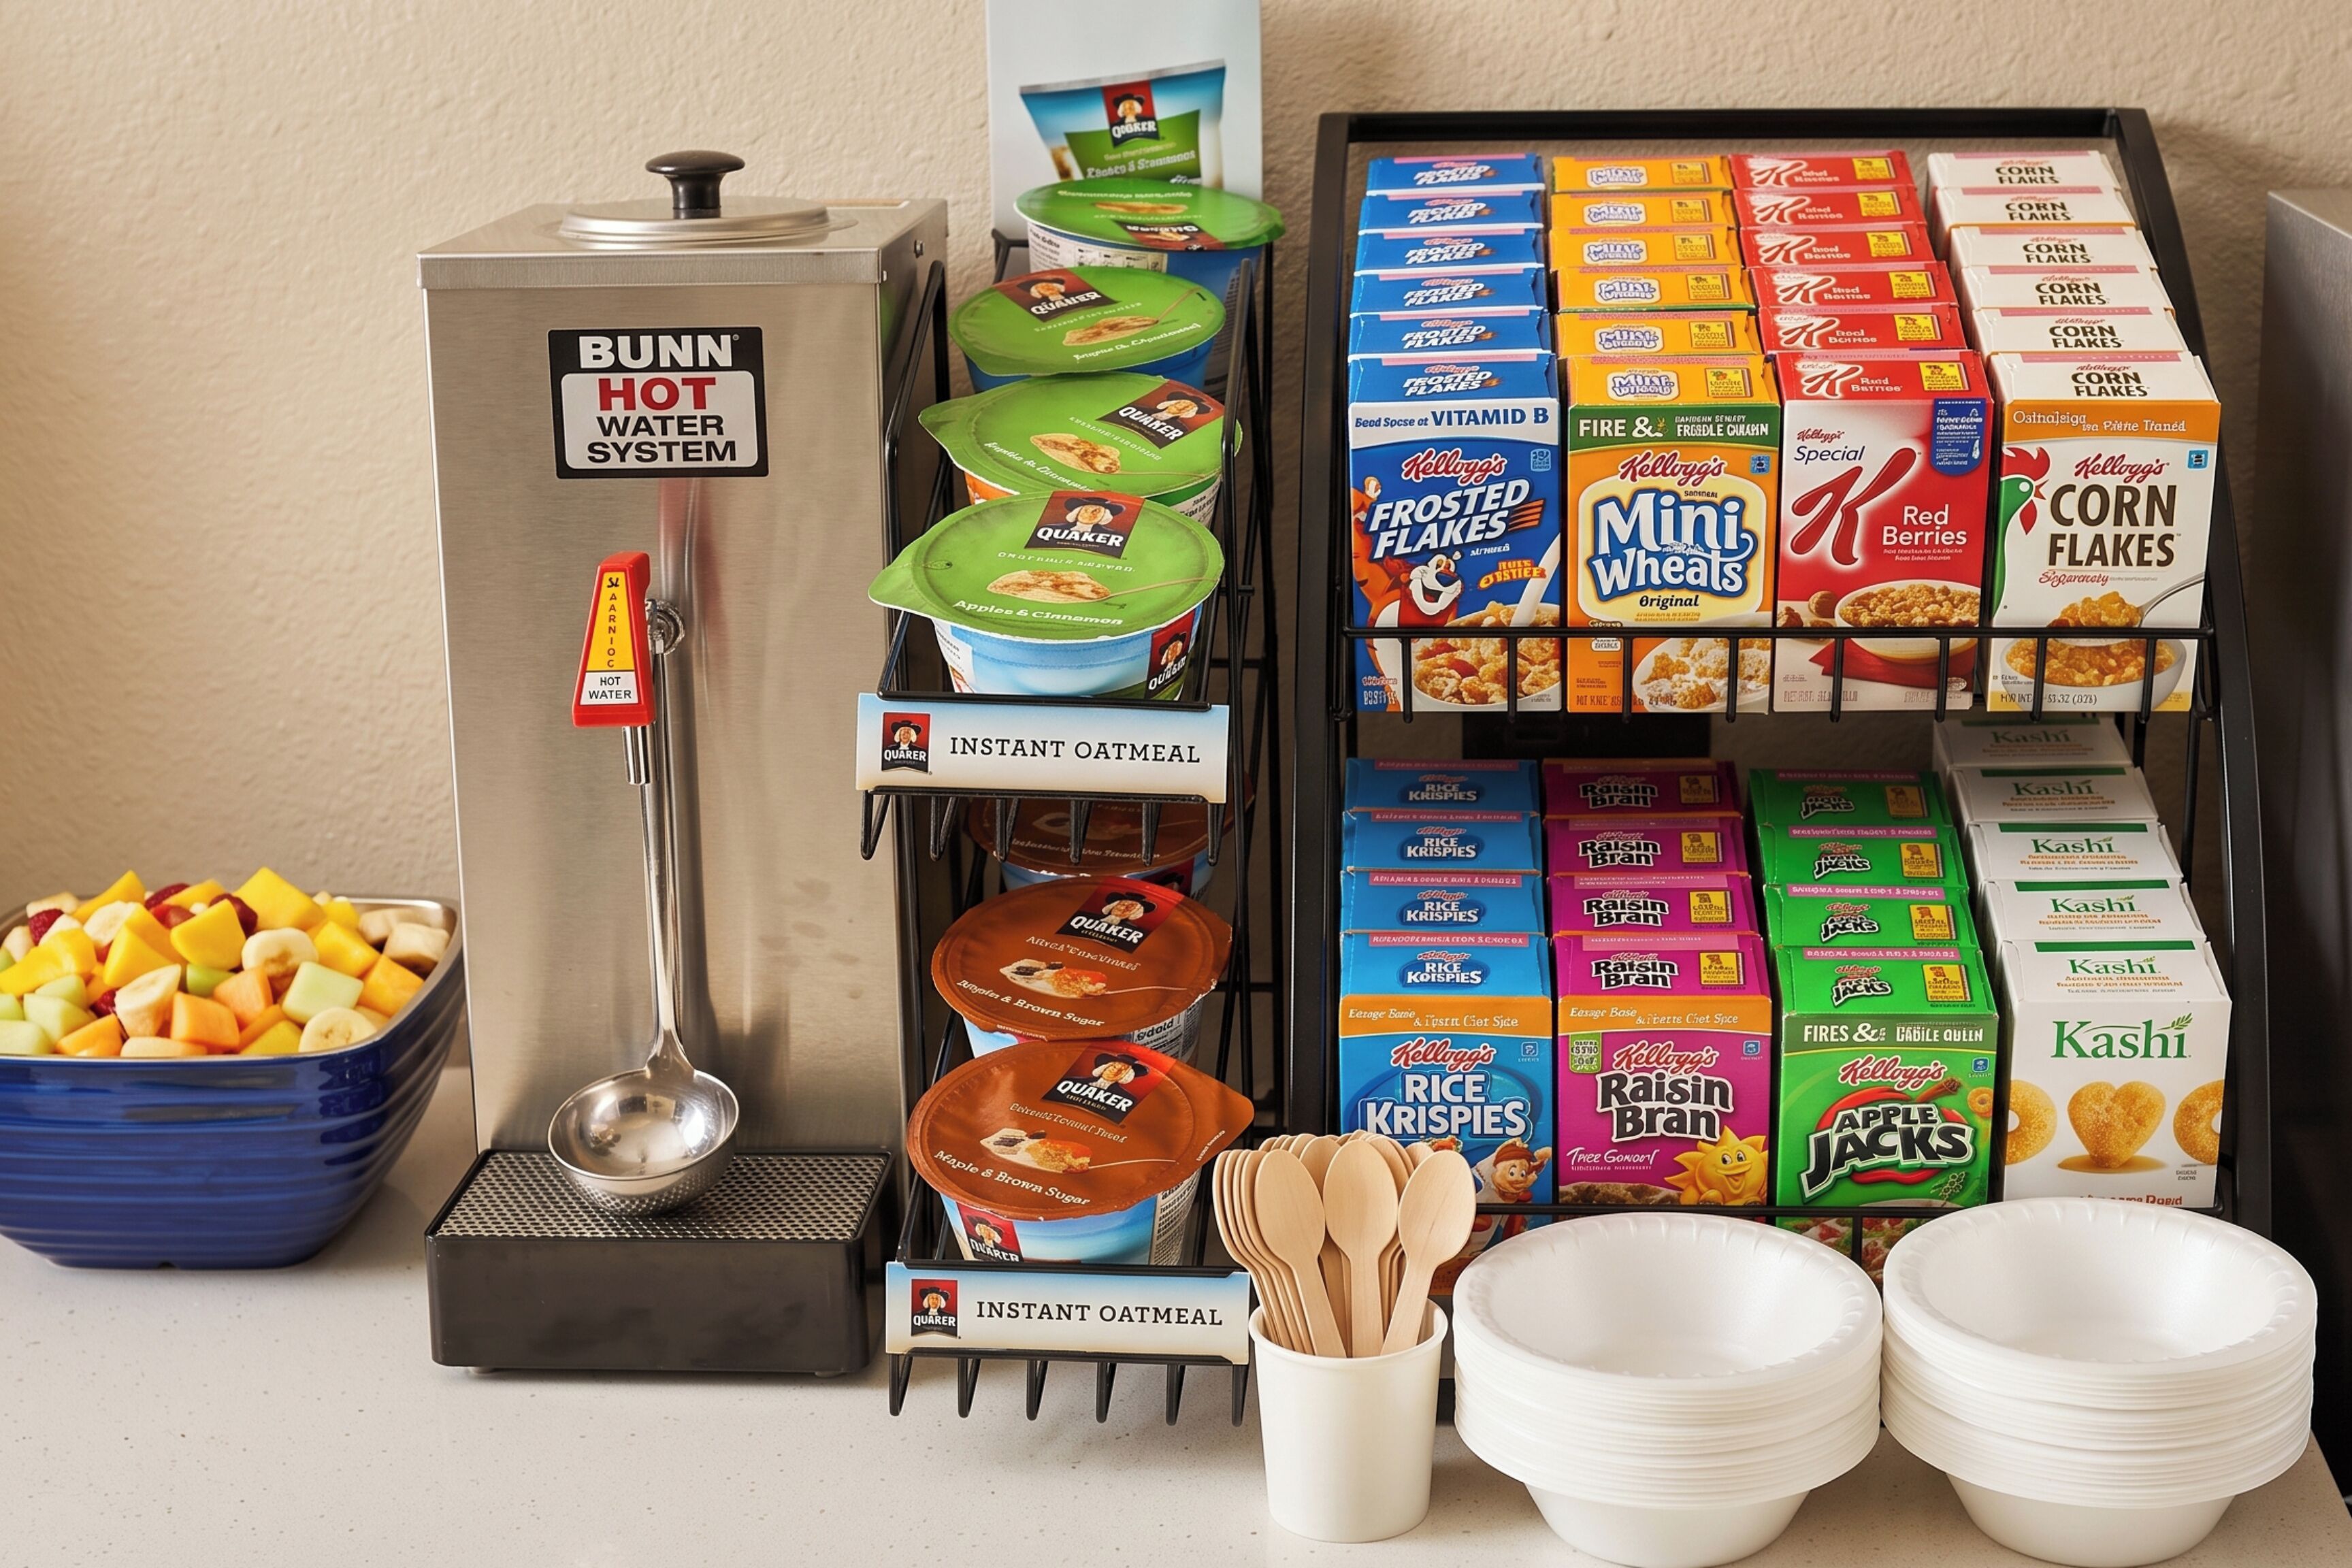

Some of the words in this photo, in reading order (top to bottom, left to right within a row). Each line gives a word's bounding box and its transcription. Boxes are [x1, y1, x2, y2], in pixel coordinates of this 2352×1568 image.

[1995, 166, 2055, 176] CORN
[1998, 176, 2059, 184] FLAKES
[2005, 202, 2068, 212] CORN
[2009, 212, 2070, 221] FLAKES
[2023, 244, 2087, 254] CORN
[2026, 254, 2091, 263] FLAKES
[2035, 282, 2102, 293] CORN
[2038, 295, 2106, 305] FLAKES
[2048, 326, 2117, 337] CORN
[579, 334, 733, 370] BUNN
[2052, 338, 2122, 348] FLAKES
[2071, 372, 2142, 384] CORN
[598, 377, 717, 411] HOT
[2074, 385, 2148, 397] FLAKES
[596, 415, 724, 436] WATER
[1533, 408, 1550, 424] B
[1579, 419, 1627, 437] FIRE
[587, 440, 736, 463] SYSTEM
[1794, 445, 1865, 465] Special
[1403, 449, 1505, 483] Kellogg's
[1620, 451, 1725, 487] Kellogg's
[2074, 453, 2166, 483] Kellogg's
[1368, 478, 1529, 532] FROSTED
[1790, 447, 1917, 566] K
[2050, 483, 2177, 527] CORN
[1597, 491, 1740, 555] Mini
[1902, 504, 1949, 526] Red
[1036, 527, 1124, 547] QUAKER
[1373, 510, 1508, 559] FLAKES
[1882, 526, 1967, 546] Berries
[2048, 533, 2176, 568] FLAKES
[1592, 544, 1746, 597] Wheats
[1639, 593, 1699, 610] Original
[600, 676, 621, 686] HOT
[588, 690, 632, 700] WATER
[1992, 729, 2072, 742] Kashi
[950, 737, 1065, 758] INSTANT
[1075, 742, 1201, 764] OATMEAL
[2012, 780, 2092, 795] Kashi
[1407, 845, 1476, 858] KRISPIES
[1424, 837, 1458, 847] RICE
[2031, 838, 2114, 853] Kashi
[1590, 853, 1652, 868] Bran
[1424, 902, 1460, 911] RICE
[1584, 898, 1668, 915] Raisin
[2050, 898, 2129, 913] Kashi
[1406, 909, 1478, 922] KRISPIES
[1595, 912, 1662, 927] Bran
[1070, 915, 1144, 944] QUAKER
[1424, 962, 1462, 973] RICE
[1592, 960, 1678, 975] Raisin
[2068, 958, 2156, 974] Kashi
[1603, 973, 1671, 990] Bran
[1803, 1024, 1849, 1043] FIRES
[2051, 1019, 2188, 1058] Kashi
[1393, 1039, 1494, 1071] Kellogg's
[1615, 1040, 1718, 1074] Kellogg's
[1841, 1056, 1945, 1089] Kellogg's
[1056, 1080, 1133, 1113] QUAKER
[1405, 1074, 1486, 1103] RICE
[1600, 1072, 1730, 1110] Raisin
[1366, 1100, 1526, 1137] KRISPIES
[1614, 1106, 1717, 1140] Bran
[1835, 1106, 1938, 1132] APPLE
[1806, 1124, 1967, 1191] JACKS
[977, 1301, 1090, 1322] INSTANT
[1099, 1305, 1223, 1326] OATMEAL
